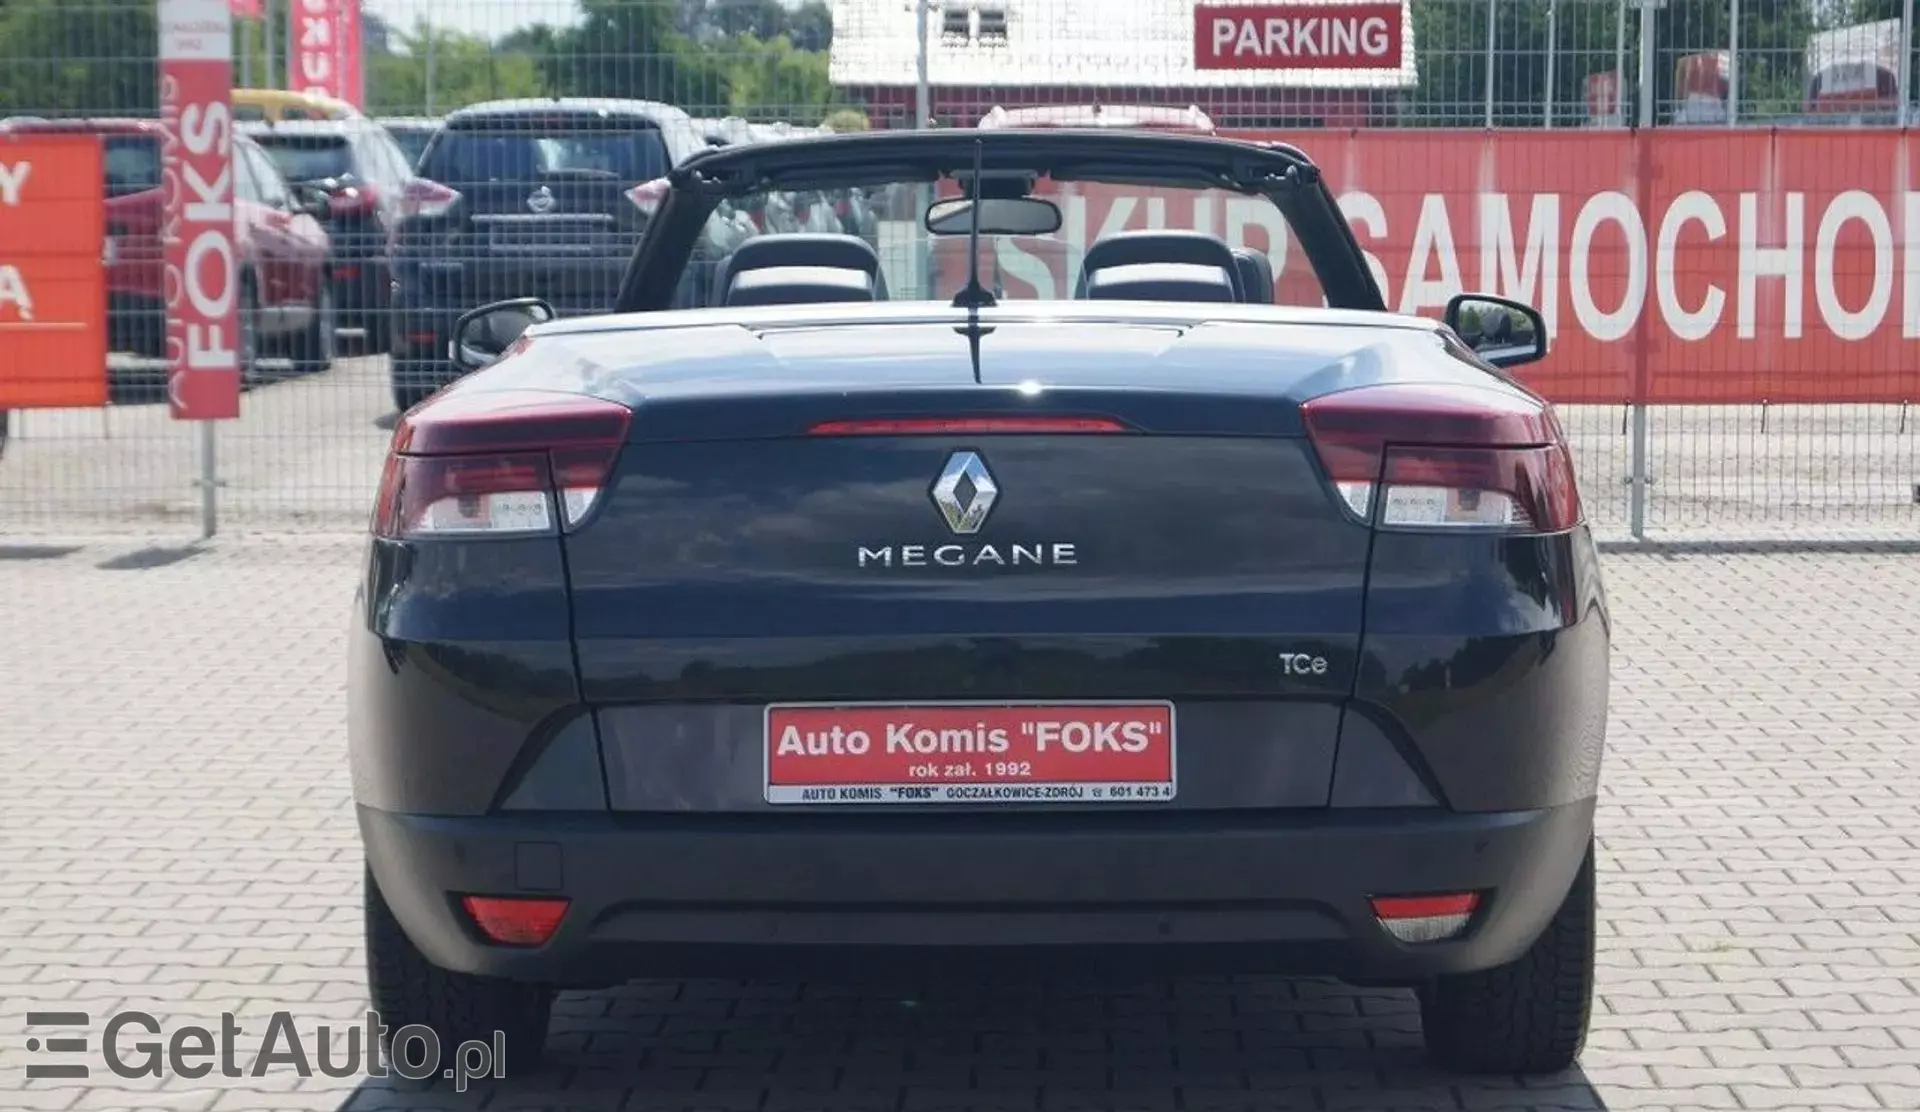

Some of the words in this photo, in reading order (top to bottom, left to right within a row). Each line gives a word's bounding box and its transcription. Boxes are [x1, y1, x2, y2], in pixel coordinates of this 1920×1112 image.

[1212, 17, 1389, 57] PARKING
[180, 100, 238, 370] FOKS
[858, 543, 1078, 567] MEGANE
[1279, 653, 1328, 675] TCe
[776, 724, 870, 756] Auto
[886, 721, 1010, 754] Komis
[1021, 721, 1162, 753] "FOKS"
[909, 763, 939, 778] rok
[944, 761, 977, 778] zał.
[985, 761, 1032, 777] 1992
[802, 787, 836, 800] AUTO
[839, 786, 882, 799] KOMIS
[1110, 786, 1132, 798] 601
[1136, 786, 1159, 798] 473
